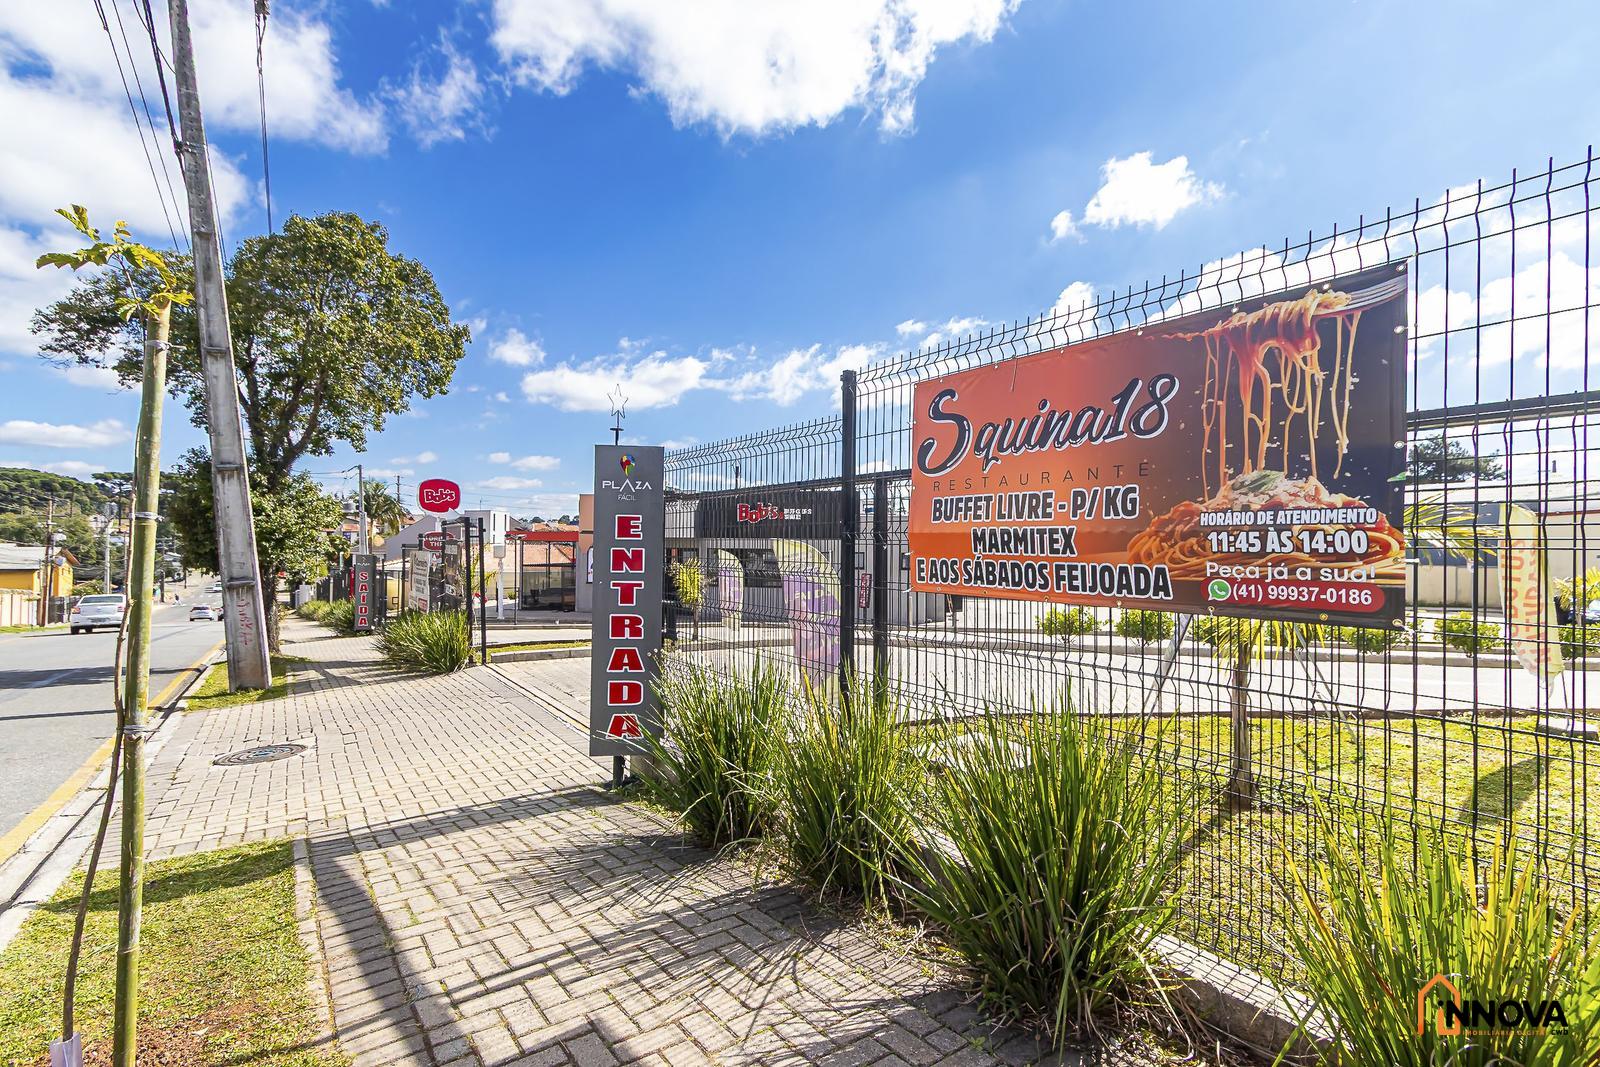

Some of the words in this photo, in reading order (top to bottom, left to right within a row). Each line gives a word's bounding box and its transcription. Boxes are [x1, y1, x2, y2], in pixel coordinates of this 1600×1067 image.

[917, 373, 1180, 477] Squina18
[602, 477, 652, 493] PLAZA
[933, 462, 1150, 492] RESTAURANTE
[423, 488, 456, 504] Bob's
[617, 491, 637, 501] FÁCIL
[931, 492, 994, 524] BUFFET
[996, 489, 1056, 522] LIVRE
[1199, 509, 1258, 527] HORÁRIO
[1259, 510, 1276, 525] DE
[1276, 507, 1378, 526] ATENDIMENTO
[970, 525, 1078, 557] MARMITEX
[1207, 530, 1262, 554] 11:45
[1264, 527, 1295, 554] ÀS
[1296, 529, 1370, 554] 14:00
[916, 558, 927, 583] E
[928, 557, 961, 585] AOS
[962, 553, 1050, 592] SÁBADOS
[1053, 562, 1174, 600] FEIJOADA
[1205, 562, 1261, 583] Peça
[1264, 562, 1289, 583] já
[1295, 567, 1312, 581] a
[1318, 564, 1376, 583] sua!
[358, 571, 369, 627] SAÍDA
[1233, 583, 1264, 602] (41)
[1267, 584, 1373, 606] 99937-0186
[605, 515, 645, 739] ENTRADA
